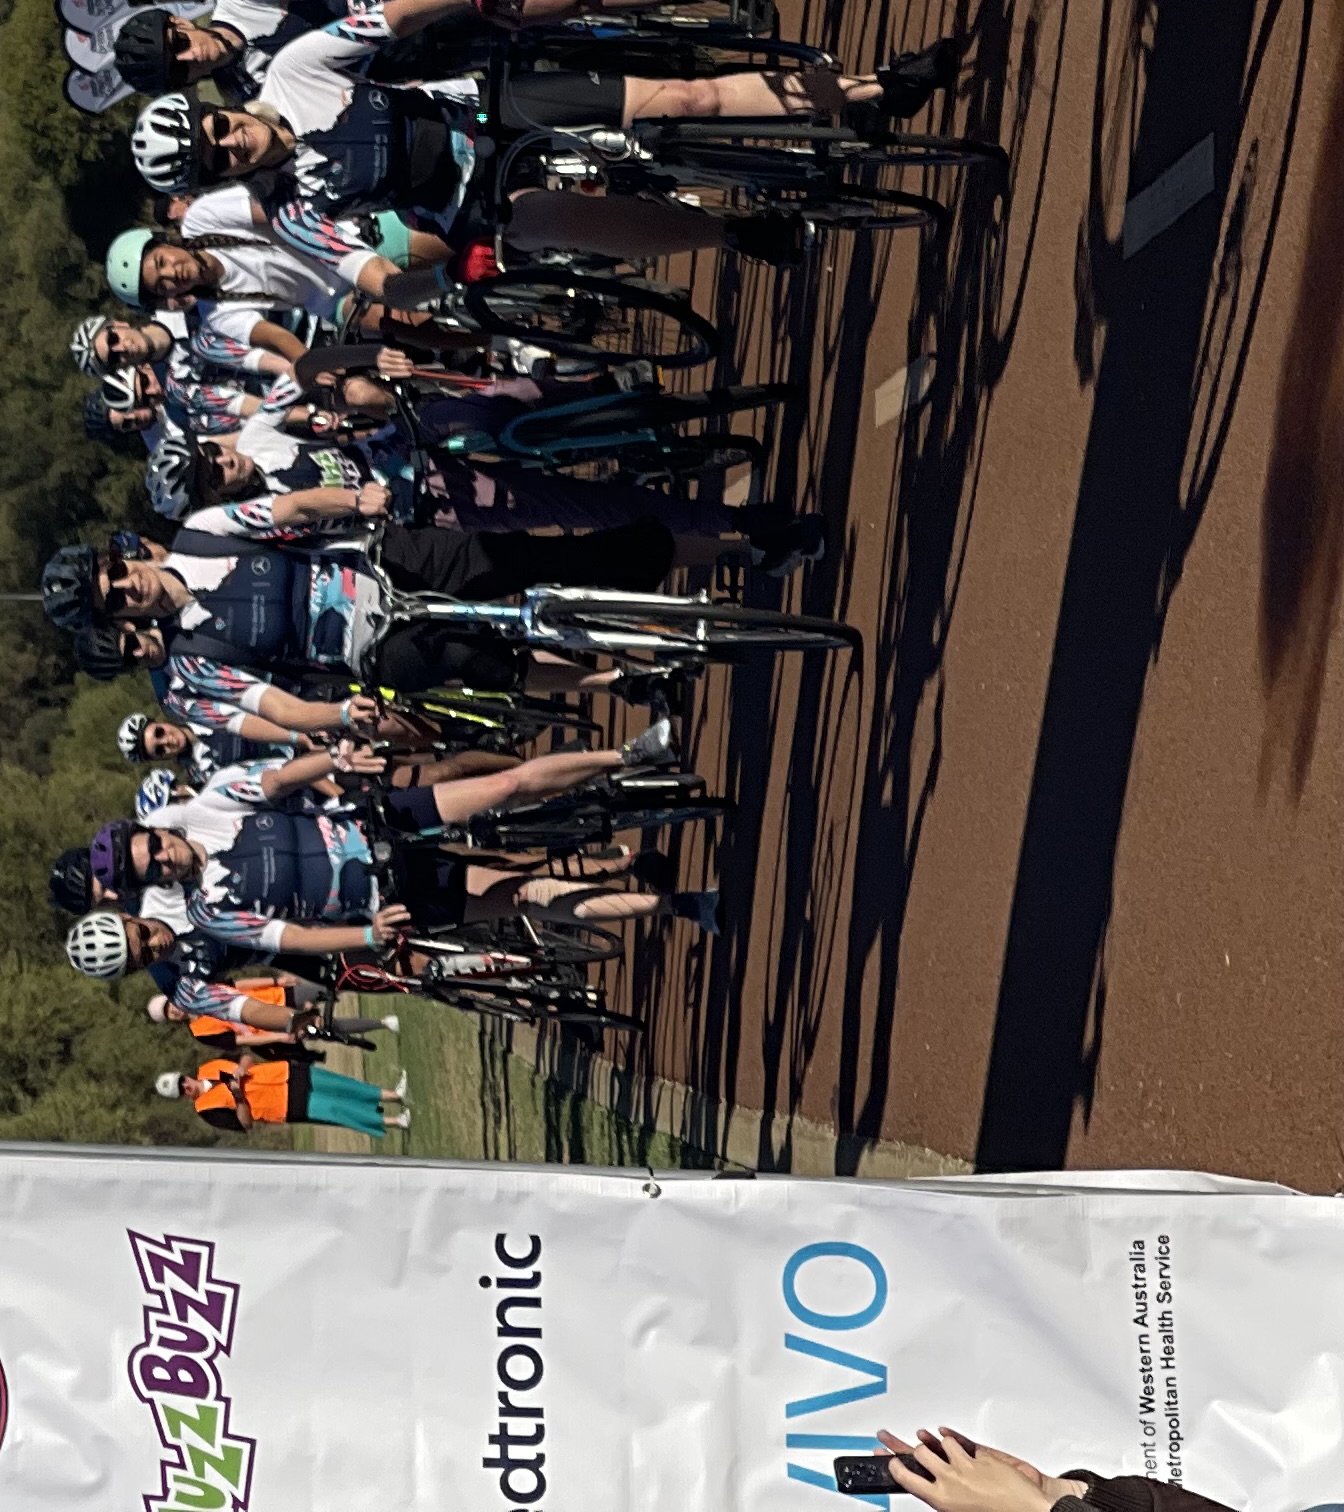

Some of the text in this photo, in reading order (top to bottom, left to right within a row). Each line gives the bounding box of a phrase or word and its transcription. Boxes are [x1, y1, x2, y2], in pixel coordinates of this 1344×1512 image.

[1129, 1239, 1150, 1328] Australia
[1154, 1234, 1173, 1304] Service
[479, 1233, 546, 1512] dtronic
[1136, 1334, 1156, 1414] Western
[1157, 1310, 1176, 1370] Health
[1139, 1419, 1156, 1437] of
